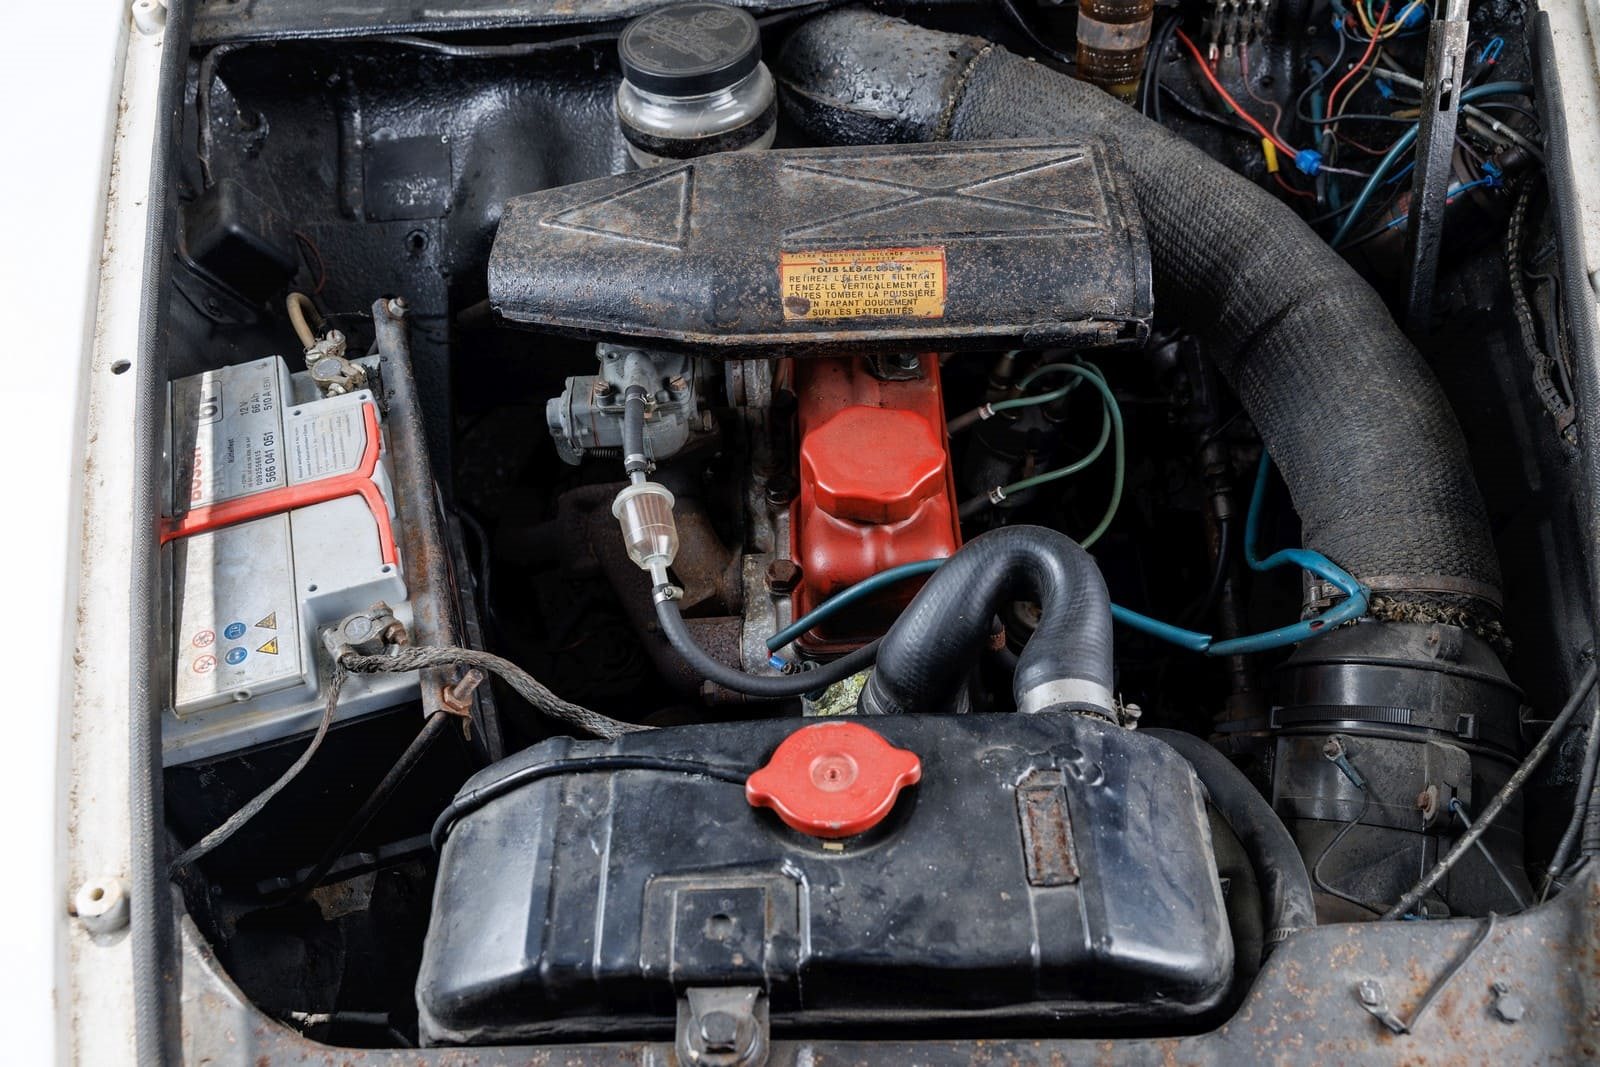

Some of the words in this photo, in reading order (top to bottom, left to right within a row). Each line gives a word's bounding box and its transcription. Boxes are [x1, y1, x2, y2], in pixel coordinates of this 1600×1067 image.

[842, 265, 862, 273] LES
[789, 274, 828, 283] RETIREZ
[891, 272, 935, 281] FILTRANT
[789, 282, 836, 291] TENEZ-LE
[842, 281, 918, 290] VERTICALEMENT
[924, 280, 936, 288] ET
[826, 291, 864, 299] TOMBER
[867, 290, 879, 298] LA
[883, 289, 936, 297] POUSSIÈRE
[824, 299, 860, 307] TAPANT
[864, 298, 918, 307] DOUCEMENT
[812, 308, 831, 316] SUR
[834, 308, 852, 316] LES
[250, 392, 260, 403] Ah
[252, 404, 261, 414] 66
[263, 398, 273, 411] 510
[240, 406, 249, 416] 12
[263, 431, 274, 447] 051
[264, 448, 275, 464] 041
[265, 466, 277, 483] 566
